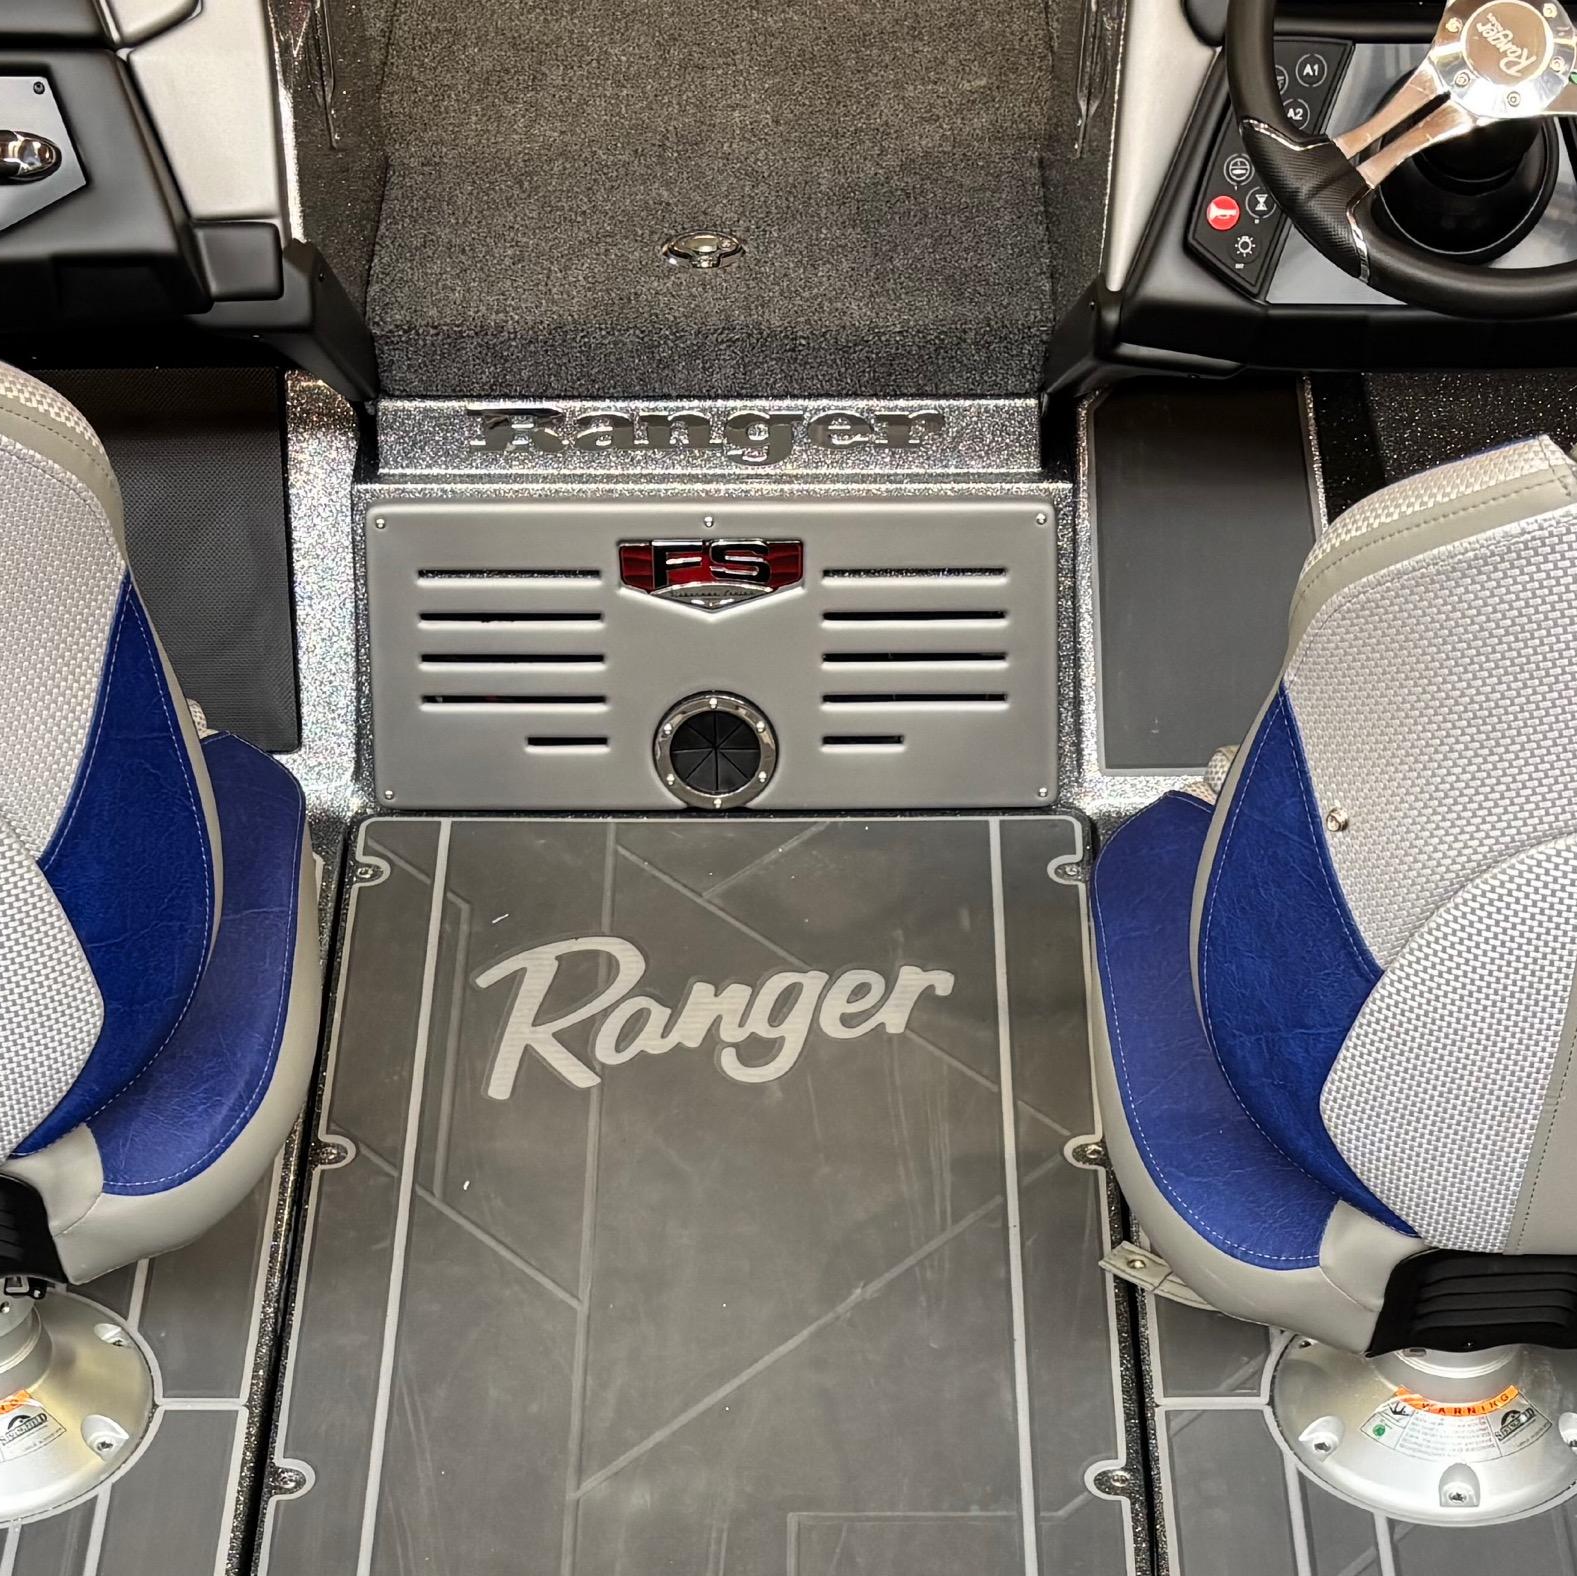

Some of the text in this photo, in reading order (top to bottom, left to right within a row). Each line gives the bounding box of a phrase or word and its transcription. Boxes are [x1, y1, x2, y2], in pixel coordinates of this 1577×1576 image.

[1302, 63, 1320, 77] A1
[1476, 22, 1537, 77] Ranger
[1286, 107, 1304, 121] A2
[466, 406, 944, 466] Ranger
[651, 539, 772, 591] FS
[475, 936, 956, 1100] Ranger
